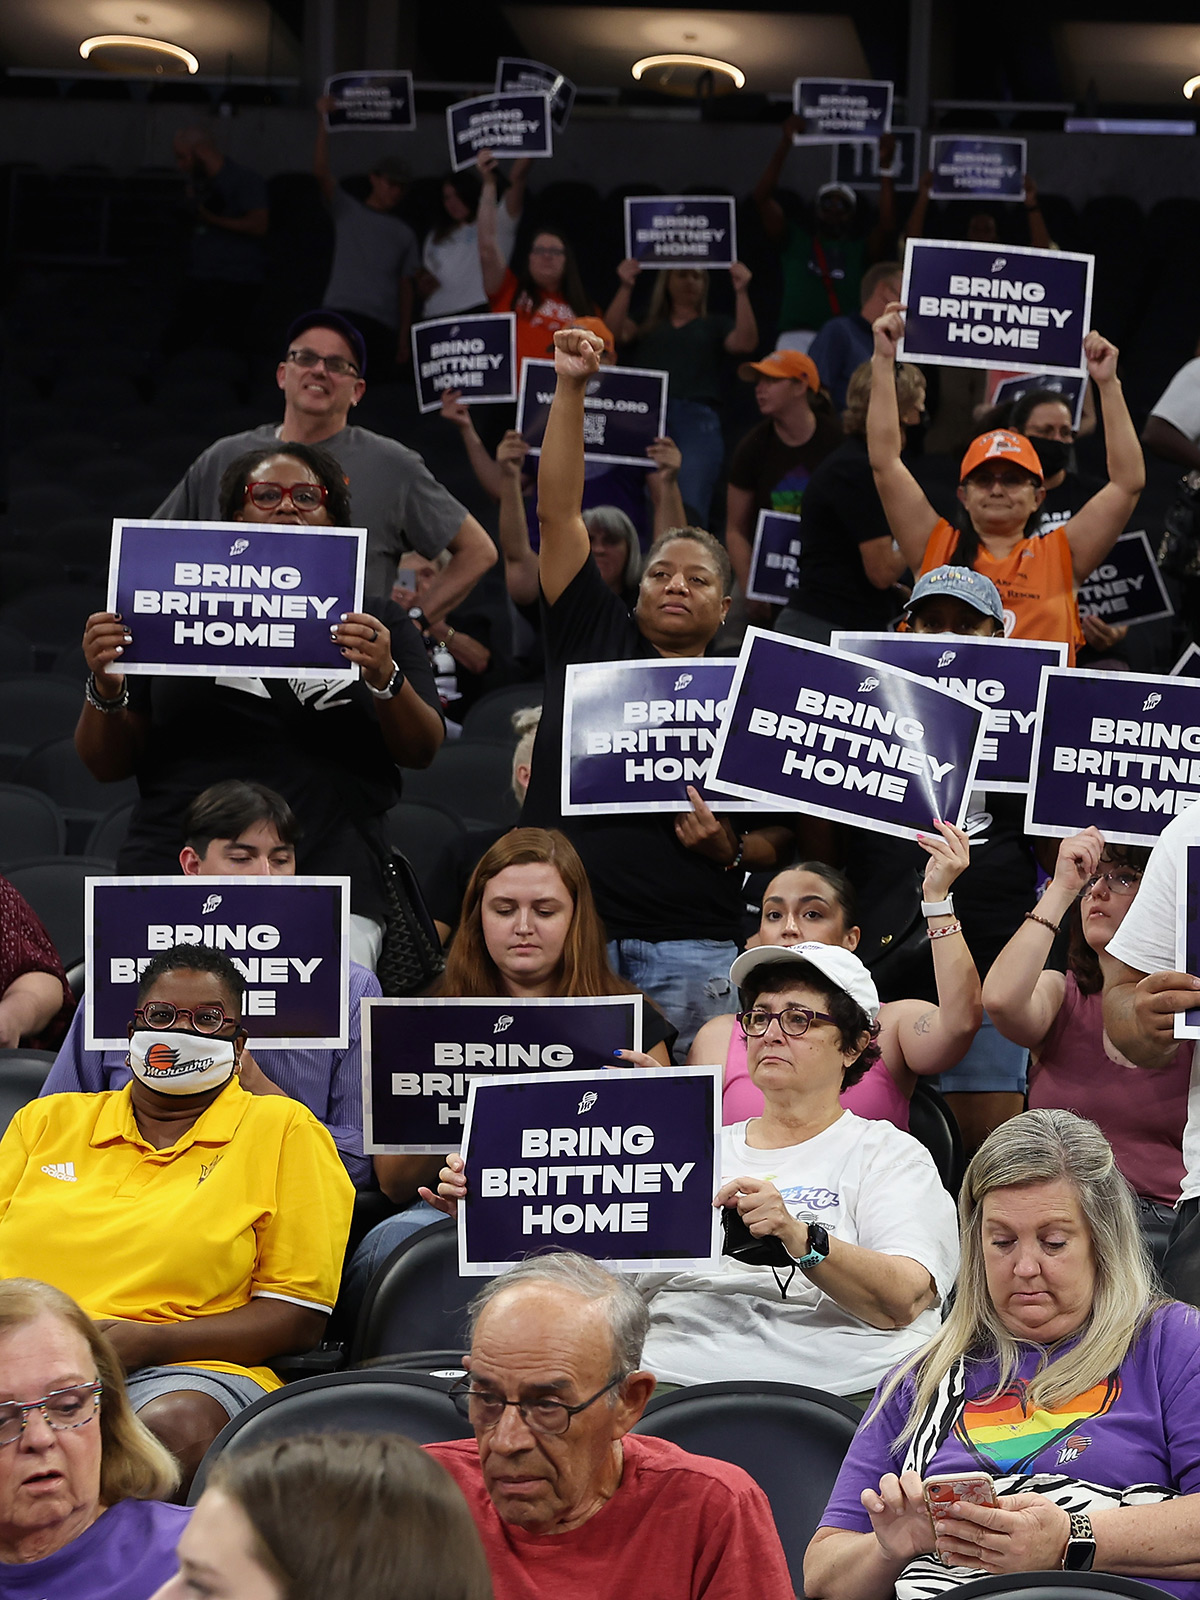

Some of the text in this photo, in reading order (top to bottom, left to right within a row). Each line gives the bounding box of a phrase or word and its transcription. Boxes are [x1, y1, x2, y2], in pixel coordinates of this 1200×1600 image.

[635, 228, 725, 243] BRITTNEY
[652, 215, 709, 229] BRING
[654, 242, 709, 256] HOME
[949, 275, 1046, 302] BRING
[918, 296, 1073, 329] BRITTNEY
[430, 338, 485, 359] BRING
[947, 322, 1040, 350] HOME
[421, 354, 503, 379] BRITTNEY
[433, 372, 485, 391] HOME
[174, 562, 302, 590] BRING
[133, 590, 340, 620] BRITTNEY
[173, 620, 296, 648] HOME
[795, 687, 925, 742] BRING
[587, 727, 720, 755] BRITTN
[748, 707, 955, 784] BRITTNEY
[625, 757, 711, 783] HOM
[782, 749, 910, 803] HOME
[147, 924, 281, 951] BRING
[434, 1042, 575, 1068] BRING
[521, 1124, 655, 1159] BRING
[40, 1165, 78, 1182] adidas
[480, 1162, 697, 1198] BRITTNEY
[522, 1202, 649, 1235] HOME
